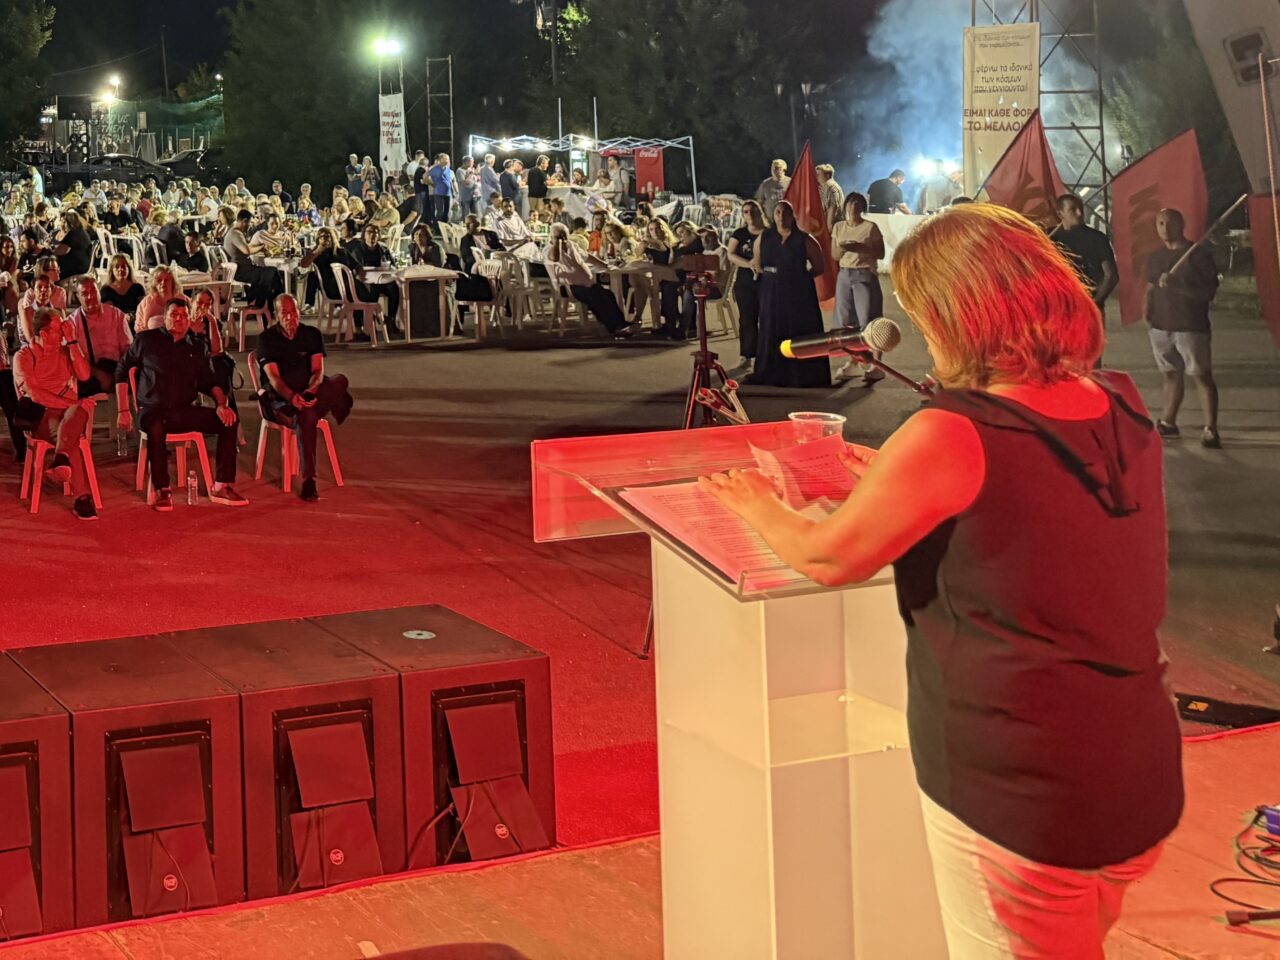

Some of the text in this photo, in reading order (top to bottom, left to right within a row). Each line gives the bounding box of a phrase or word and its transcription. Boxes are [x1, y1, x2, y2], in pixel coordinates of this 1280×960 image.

[1010, 62, 1032, 71] ιδανικά
[996, 74, 1021, 84] κόσμων
[964, 108, 1033, 117] ΕΙΜΑΙ ΚΑΘΕ ΦΟΡ
[968, 121, 981, 131] ΤΟ
